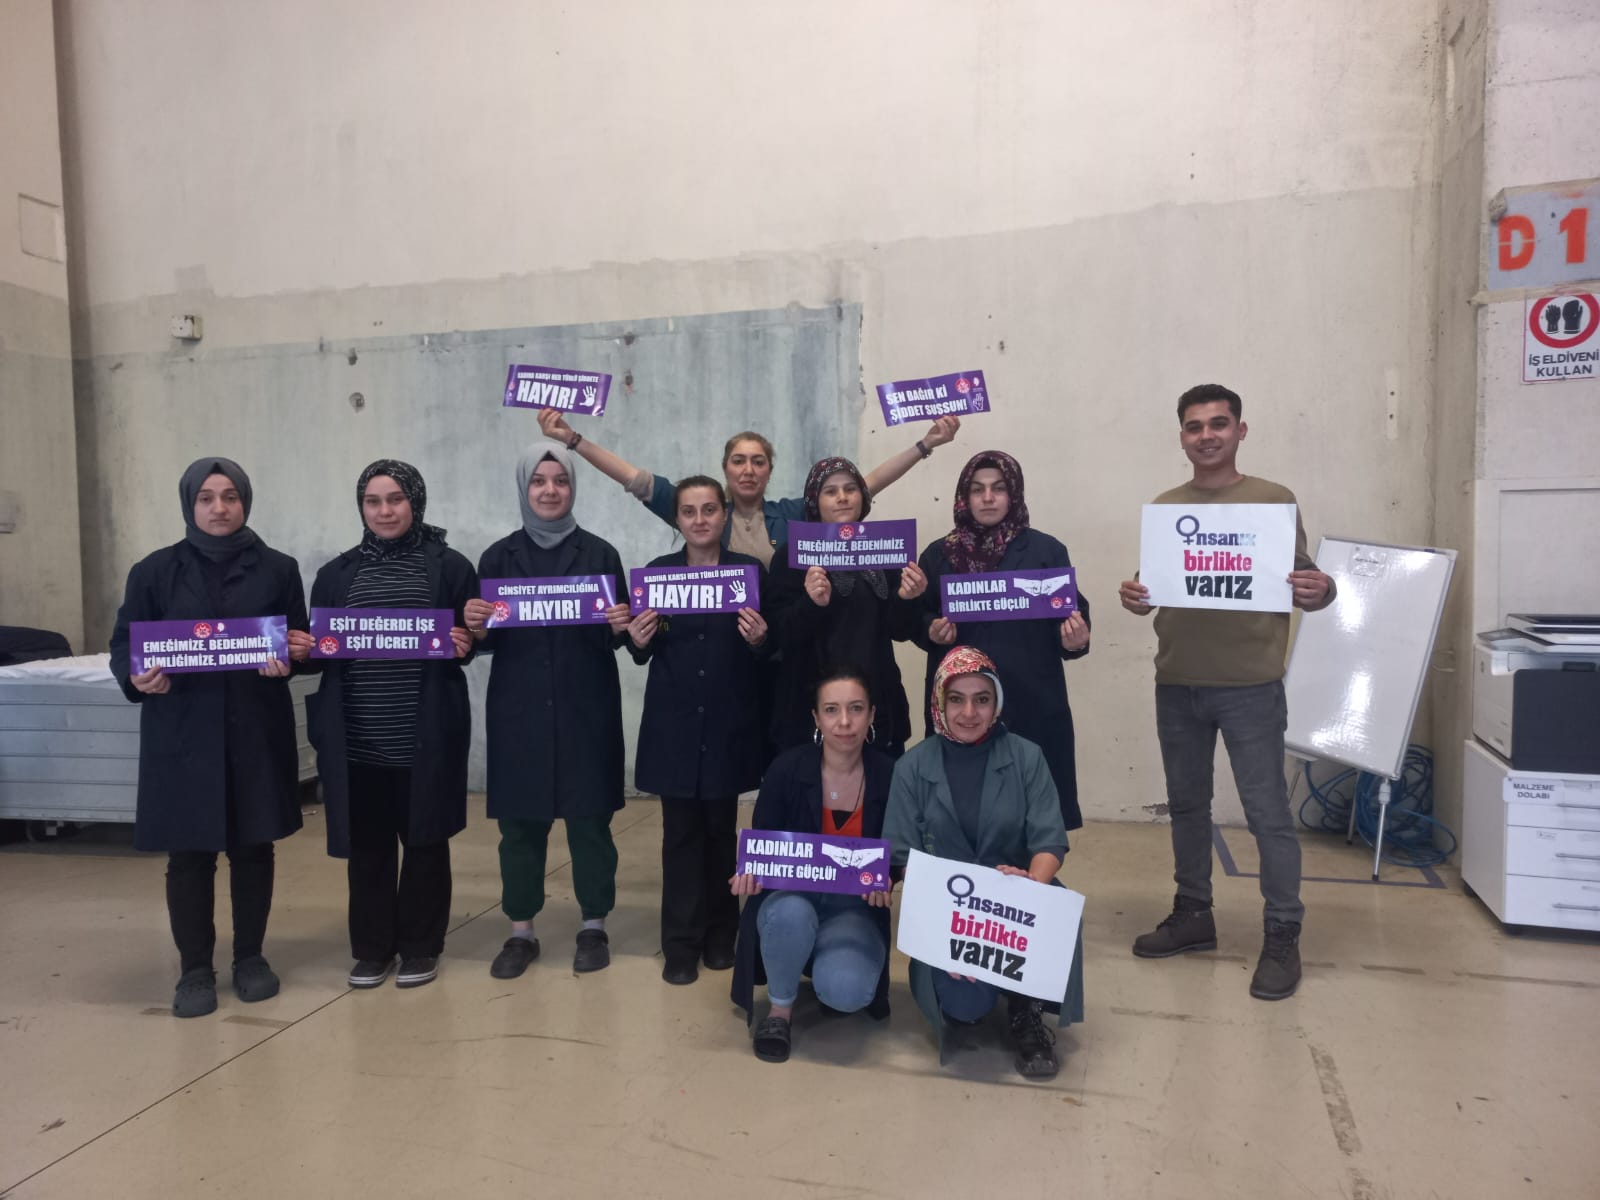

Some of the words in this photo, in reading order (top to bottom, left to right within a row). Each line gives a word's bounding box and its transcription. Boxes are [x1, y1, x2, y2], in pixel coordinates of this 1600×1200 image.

[1498, 214, 1536, 272] D
[1560, 208, 1588, 263] 1
[1529, 353, 1541, 366] İŞ
[1544, 349, 1600, 365] ELDİVENİ
[1536, 364, 1592, 377] KULLAN
[516, 380, 578, 409] HAYIR!
[886, 391, 906, 405] SEN
[935, 384, 948, 399] Kİ
[890, 405, 924, 422] ŞİDDET
[925, 399, 968, 415] SUSSUN!
[850, 537, 905, 552] BEDENİMİZE
[858, 553, 908, 565] DOKUNMA!
[1184, 550, 1252, 571] birlikte
[498, 584, 536, 596] CİNSİYET
[648, 584, 723, 608] HAYIR!
[947, 580, 1006, 596] KADINLAR
[1185, 575, 1253, 600] varız
[518, 600, 581, 621] HAYIR!
[948, 599, 992, 612] BİRLİKTE
[994, 596, 1030, 611] GÜÇLÜ!
[329, 616, 357, 633] EŞİT
[360, 616, 413, 632] DEĞERDE
[415, 616, 435, 634] İŞE
[143, 638, 206, 653] EMEĞİMİZE,
[209, 635, 272, 650] BEDENİMİZE
[346, 634, 373, 651] EŞİT
[376, 634, 419, 649] ÜCRET!
[1513, 783, 1555, 791] MALZEME
[1517, 791, 1550, 799] DOLABI
[746, 838, 814, 858] KADINLAR
[745, 860, 794, 878] BİRLİKTE
[796, 863, 837, 882] GÜÇLÜ!
[951, 911, 1028, 952] birlikte
[950, 938, 1026, 983] varız
